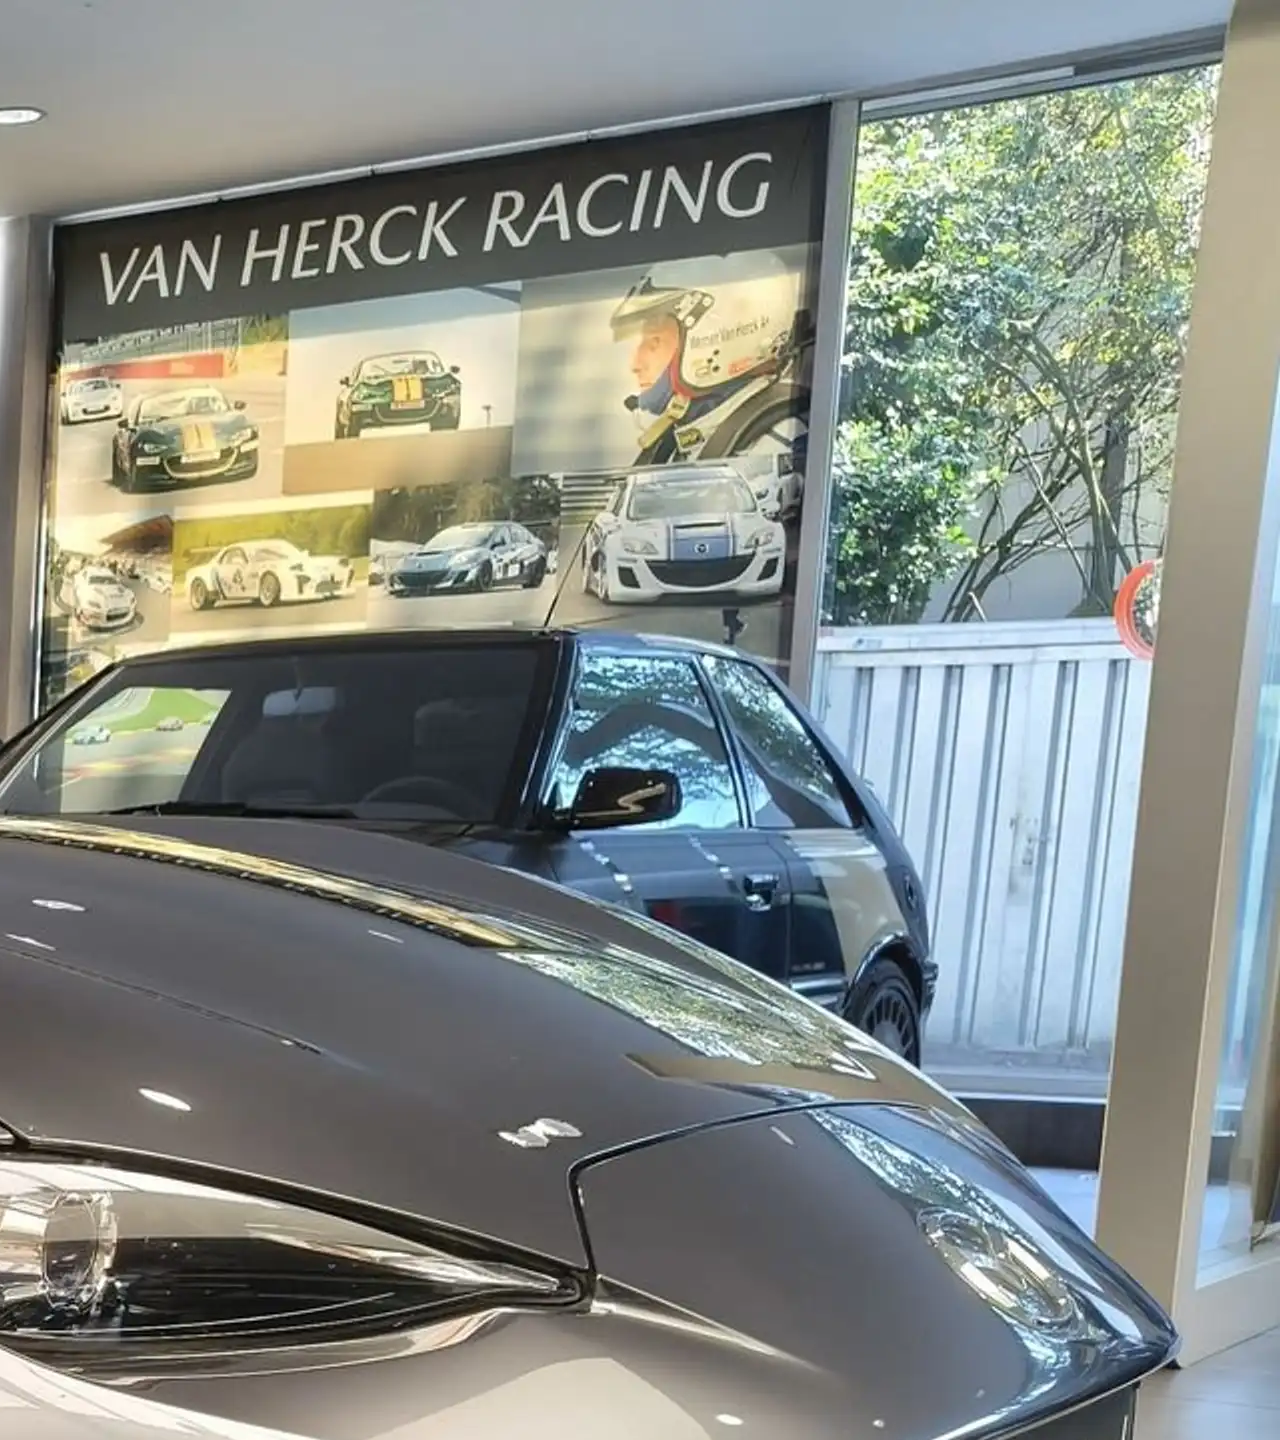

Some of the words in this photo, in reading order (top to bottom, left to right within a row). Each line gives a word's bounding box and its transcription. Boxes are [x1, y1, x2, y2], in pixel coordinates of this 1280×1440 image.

[98, 234, 222, 306] VAN
[239, 196, 468, 287] HERCK
[482, 151, 773, 252] RACING
